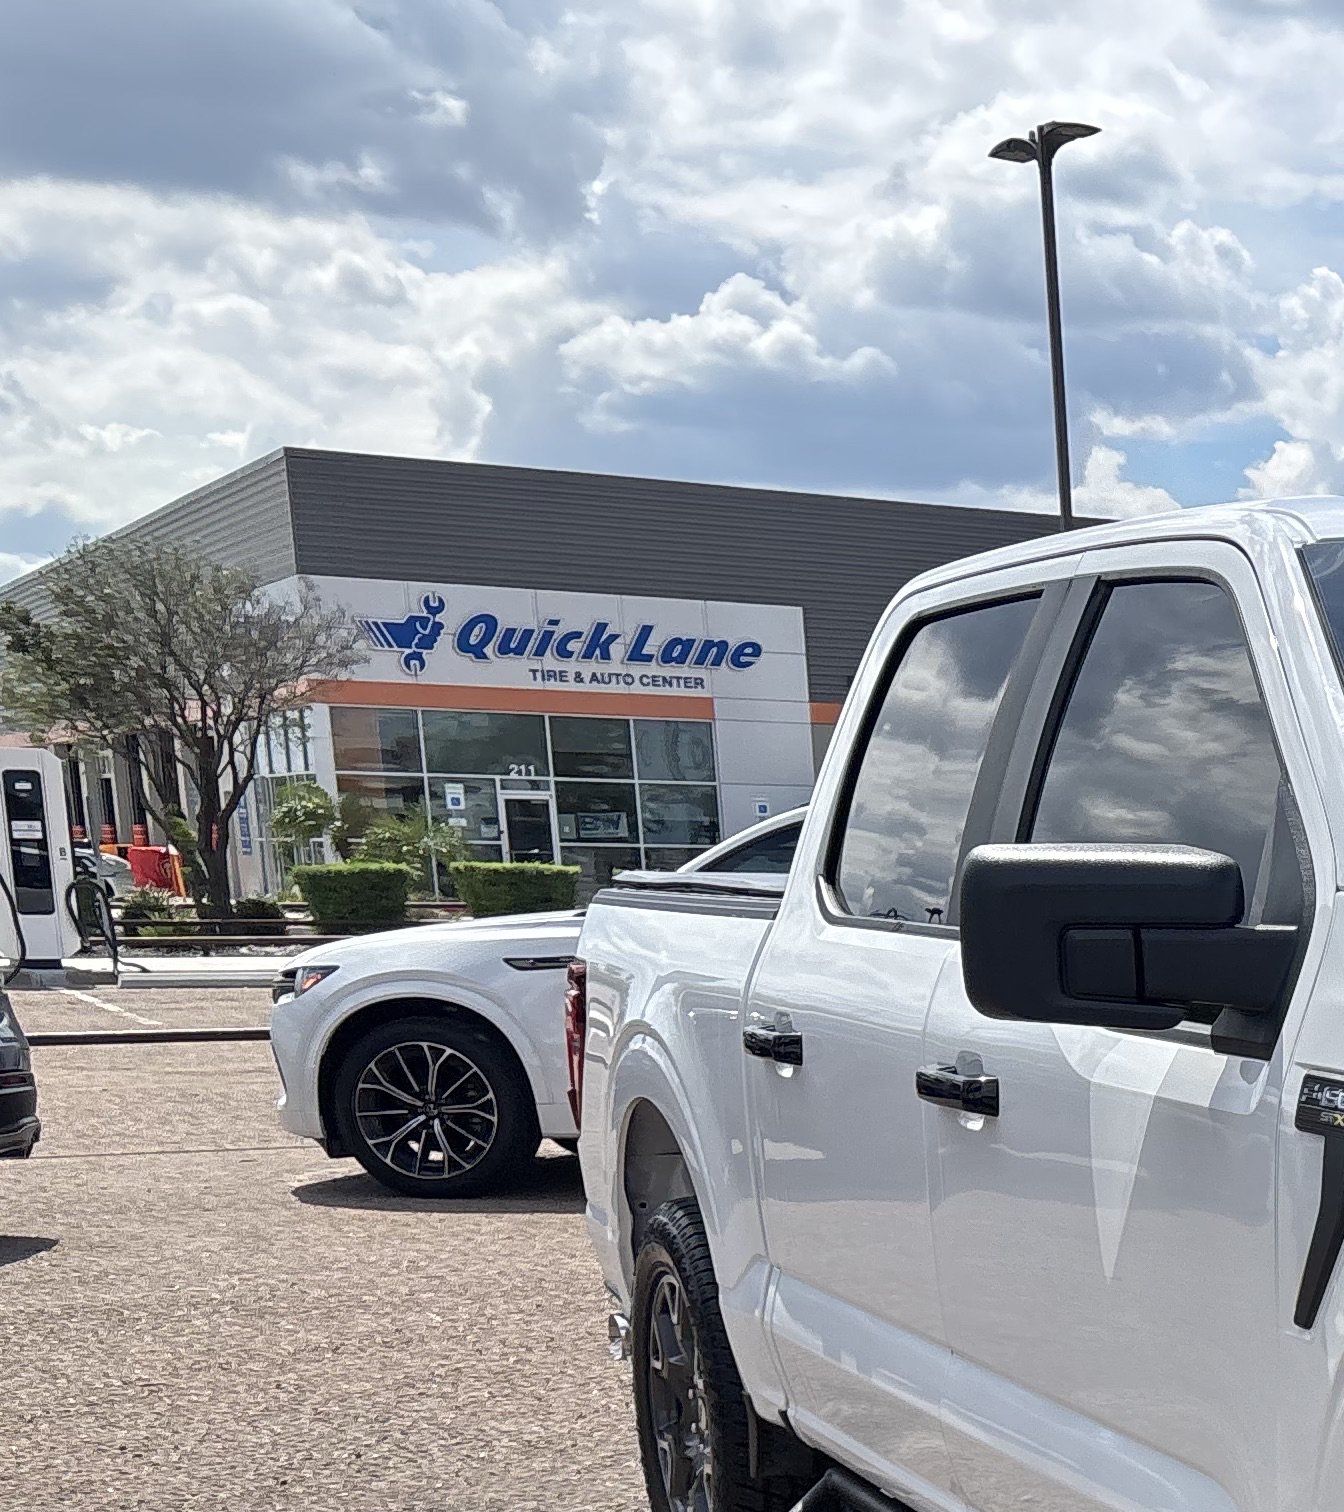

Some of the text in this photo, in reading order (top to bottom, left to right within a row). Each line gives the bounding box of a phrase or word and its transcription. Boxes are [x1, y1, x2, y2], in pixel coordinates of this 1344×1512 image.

[455, 612, 763, 669] Quick Lane
[528, 668, 706, 690] TIRE & AUTO CENTER
[508, 764, 536, 777] 211
